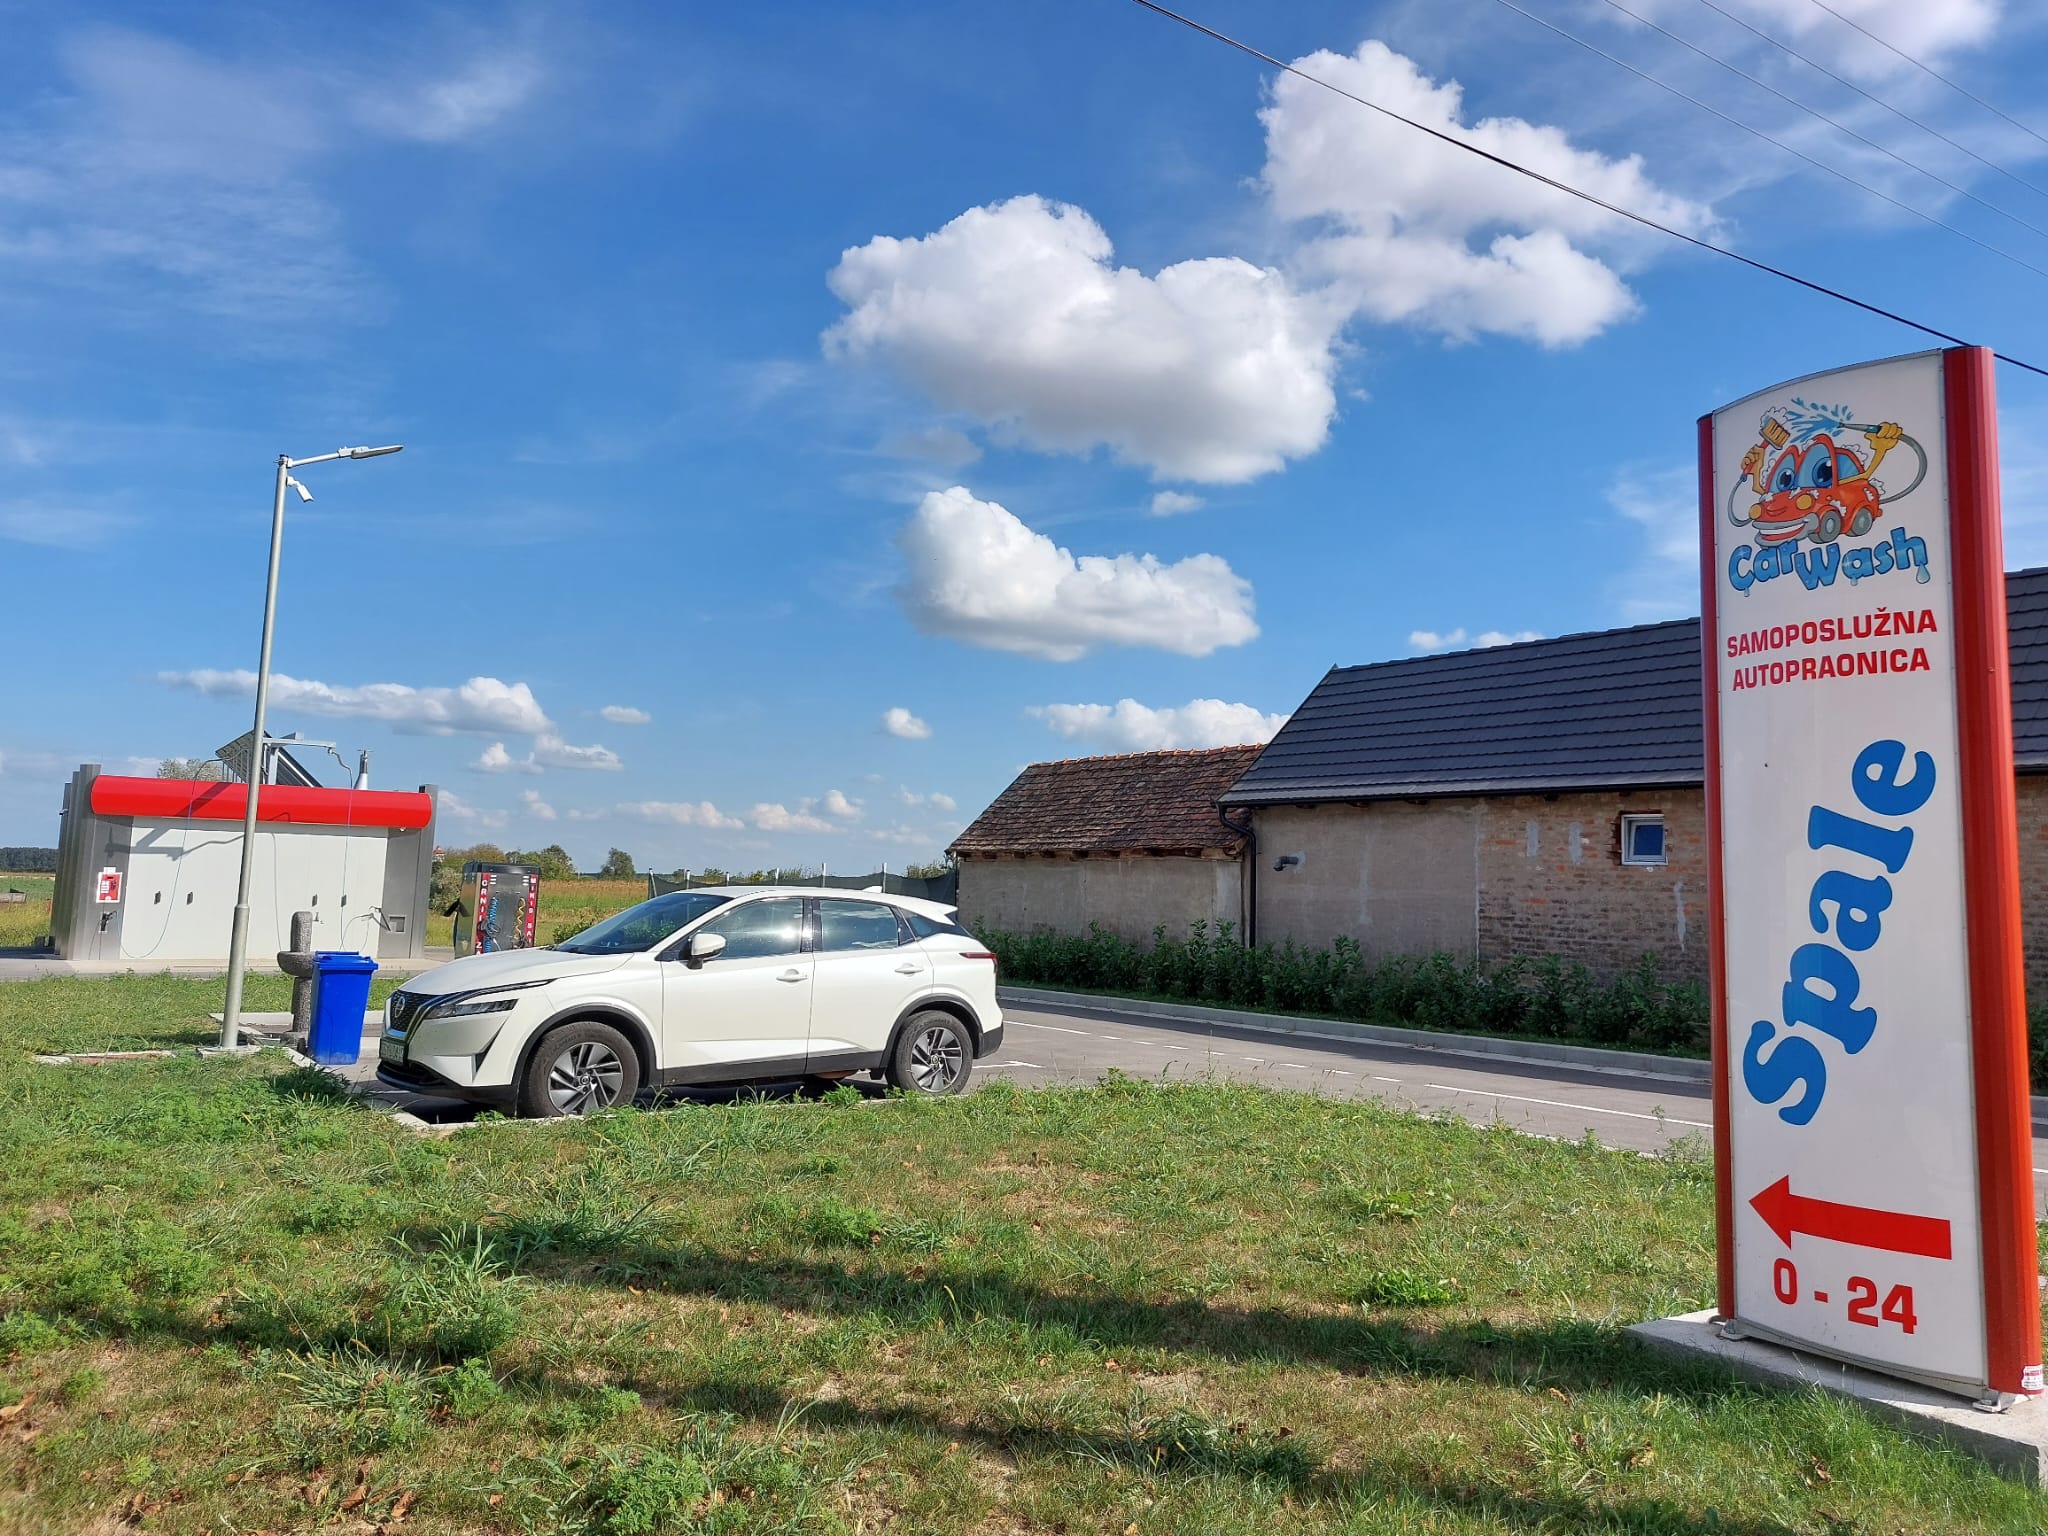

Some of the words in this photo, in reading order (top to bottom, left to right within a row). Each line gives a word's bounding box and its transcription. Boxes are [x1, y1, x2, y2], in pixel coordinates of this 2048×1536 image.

[1727, 607, 1937, 658] SAMOPOSLUŽNA
[1732, 647, 1930, 692] AUTOPRAONICA
[1742, 739, 1936, 1126] Spale
[1773, 1257, 1798, 1305] 0
[1847, 1276, 1918, 1334] 24
